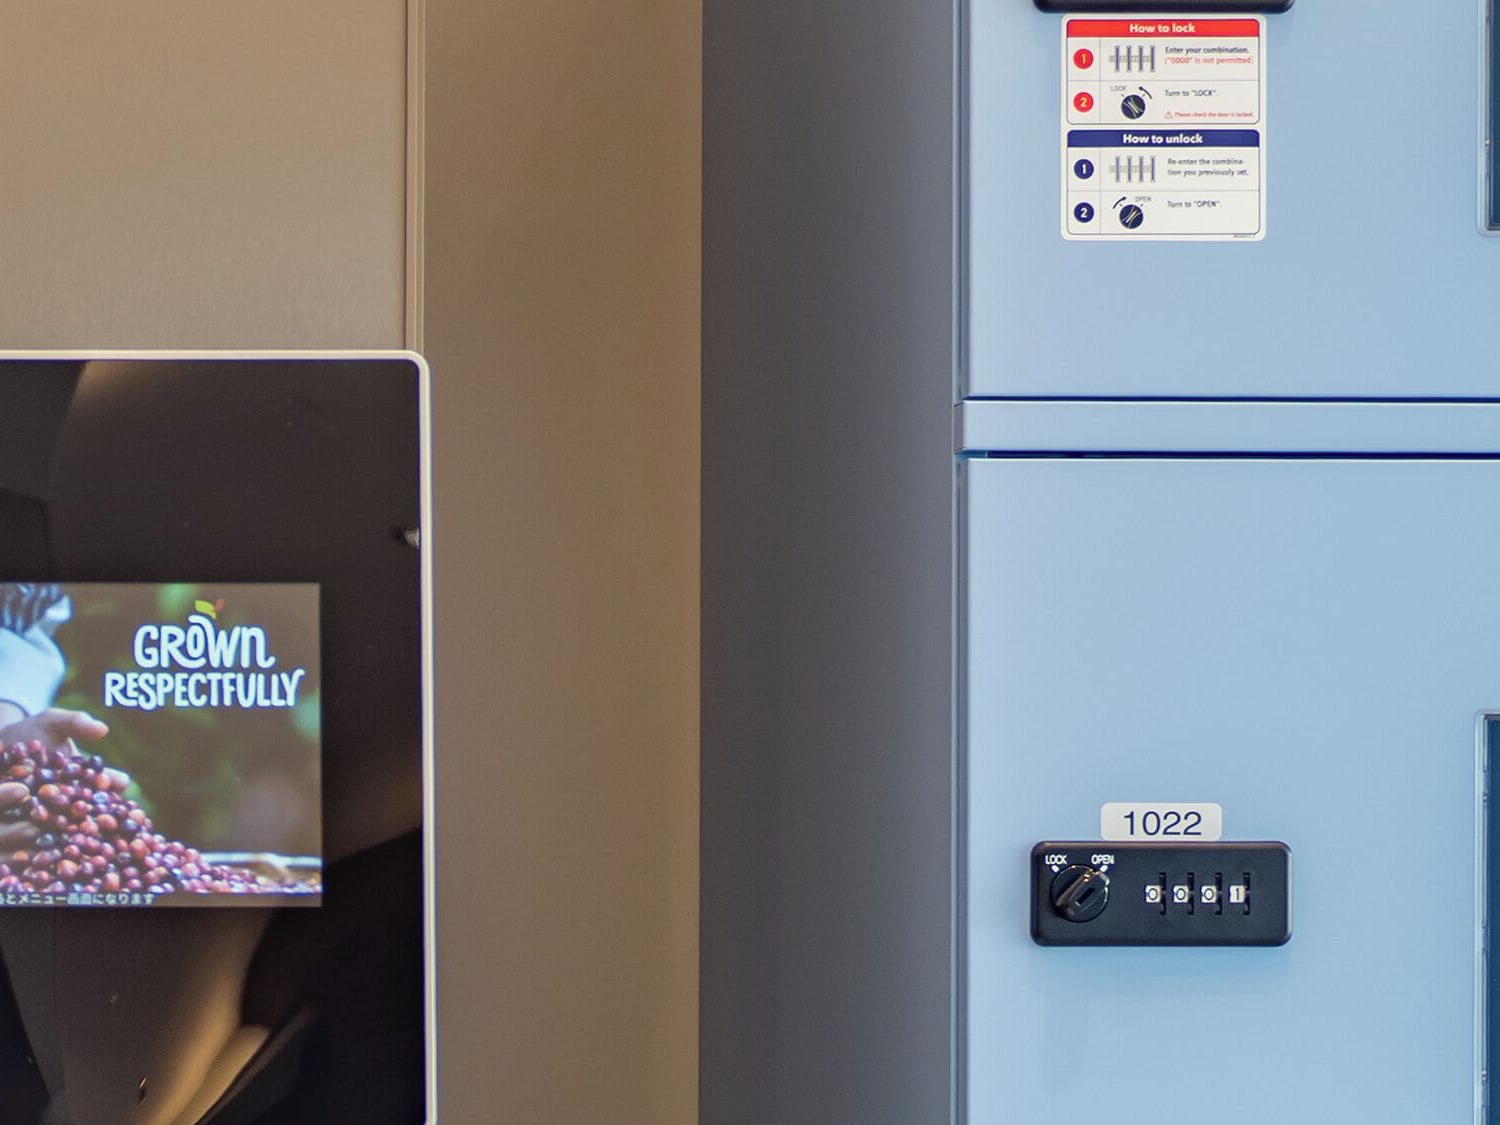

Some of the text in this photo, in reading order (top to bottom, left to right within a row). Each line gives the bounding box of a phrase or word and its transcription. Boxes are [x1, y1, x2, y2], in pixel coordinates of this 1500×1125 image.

[1129, 23, 1196, 33] How to lock
[1165, 46, 1249, 55] Enter your combination.
[1123, 134, 1203, 144] How to unlock
[1198, 169, 1235, 177] previously
[104, 668, 305, 710] RESPECTFULLY
[1123, 811, 1202, 836] 1022
[1045, 854, 1115, 865] LOCK OPEN
